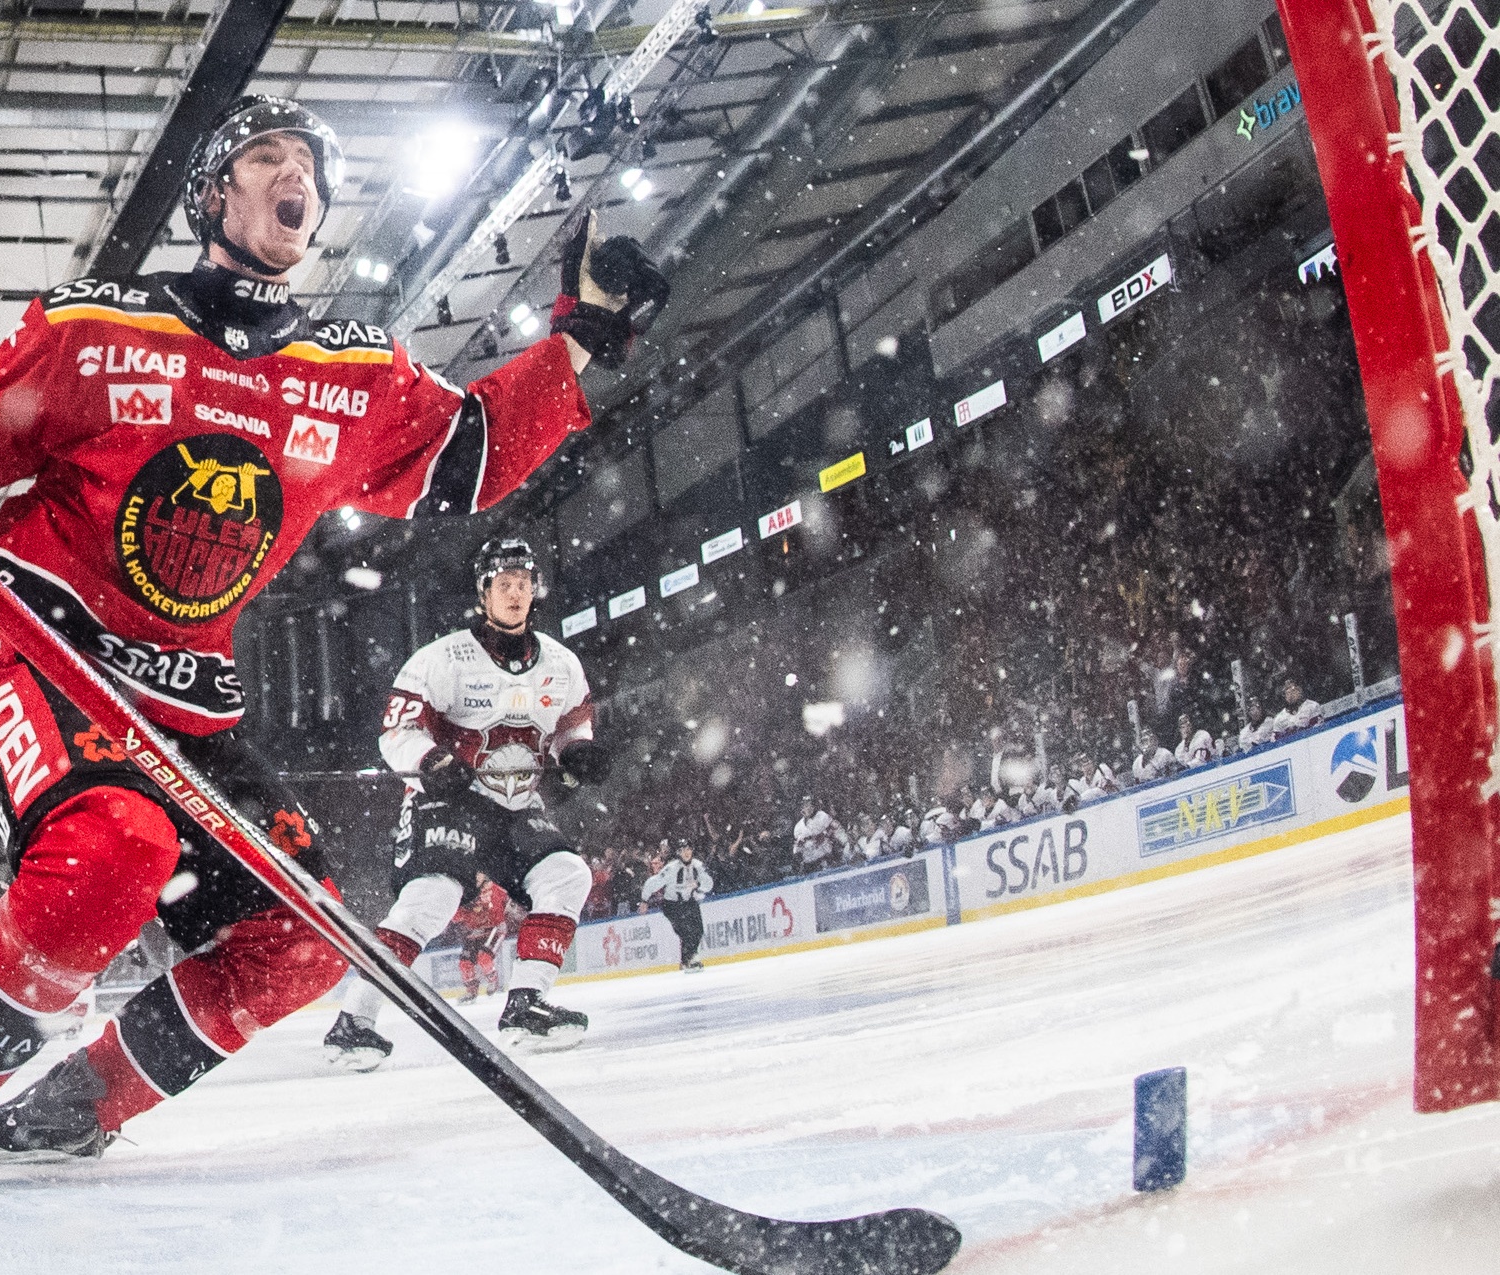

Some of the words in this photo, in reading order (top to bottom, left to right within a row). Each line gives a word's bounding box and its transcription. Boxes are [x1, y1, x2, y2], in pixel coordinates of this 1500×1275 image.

[49, 278, 150, 304] SSAB
[1111, 266, 1159, 312] BDX
[105, 345, 187, 380] LKAB
[202, 366, 239, 387] NIEMI
[115, 388, 165, 422] MAX
[307, 381, 370, 417] LKAB
[194, 403, 272, 438] SCANIA
[121, 494, 145, 557] LULEÅ
[768, 507, 794, 534] ABB
[126, 559, 252, 618] HOCKEYFÖRENING
[382, 696, 424, 728] 32
[424, 826, 477, 855] MAXI
[985, 818, 1088, 899] SSAB
[700, 917, 745, 950] NIEMI
